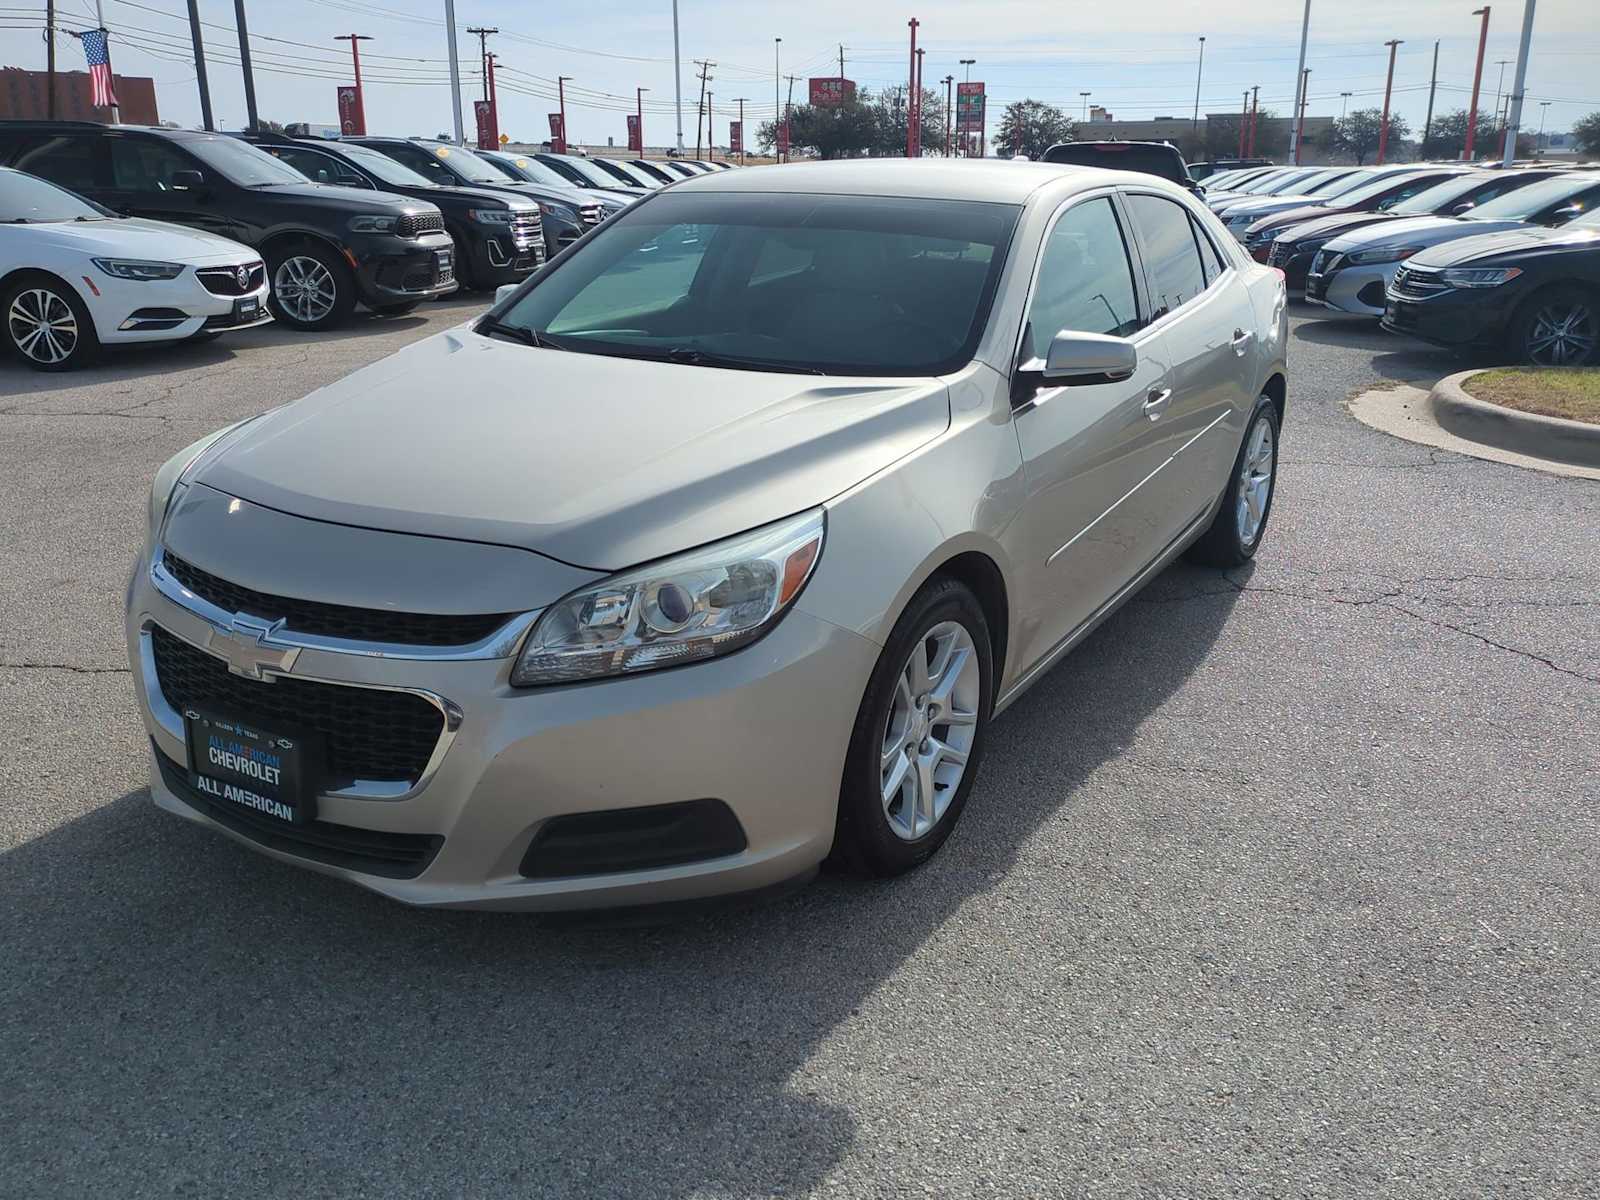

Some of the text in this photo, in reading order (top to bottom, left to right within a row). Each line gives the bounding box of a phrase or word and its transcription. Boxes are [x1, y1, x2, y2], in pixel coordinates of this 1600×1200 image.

[208, 735, 281, 768] ALL AMERICAN
[208, 747, 281, 786] CHEVROLET
[197, 775, 293, 822] ALL AMERICAN
